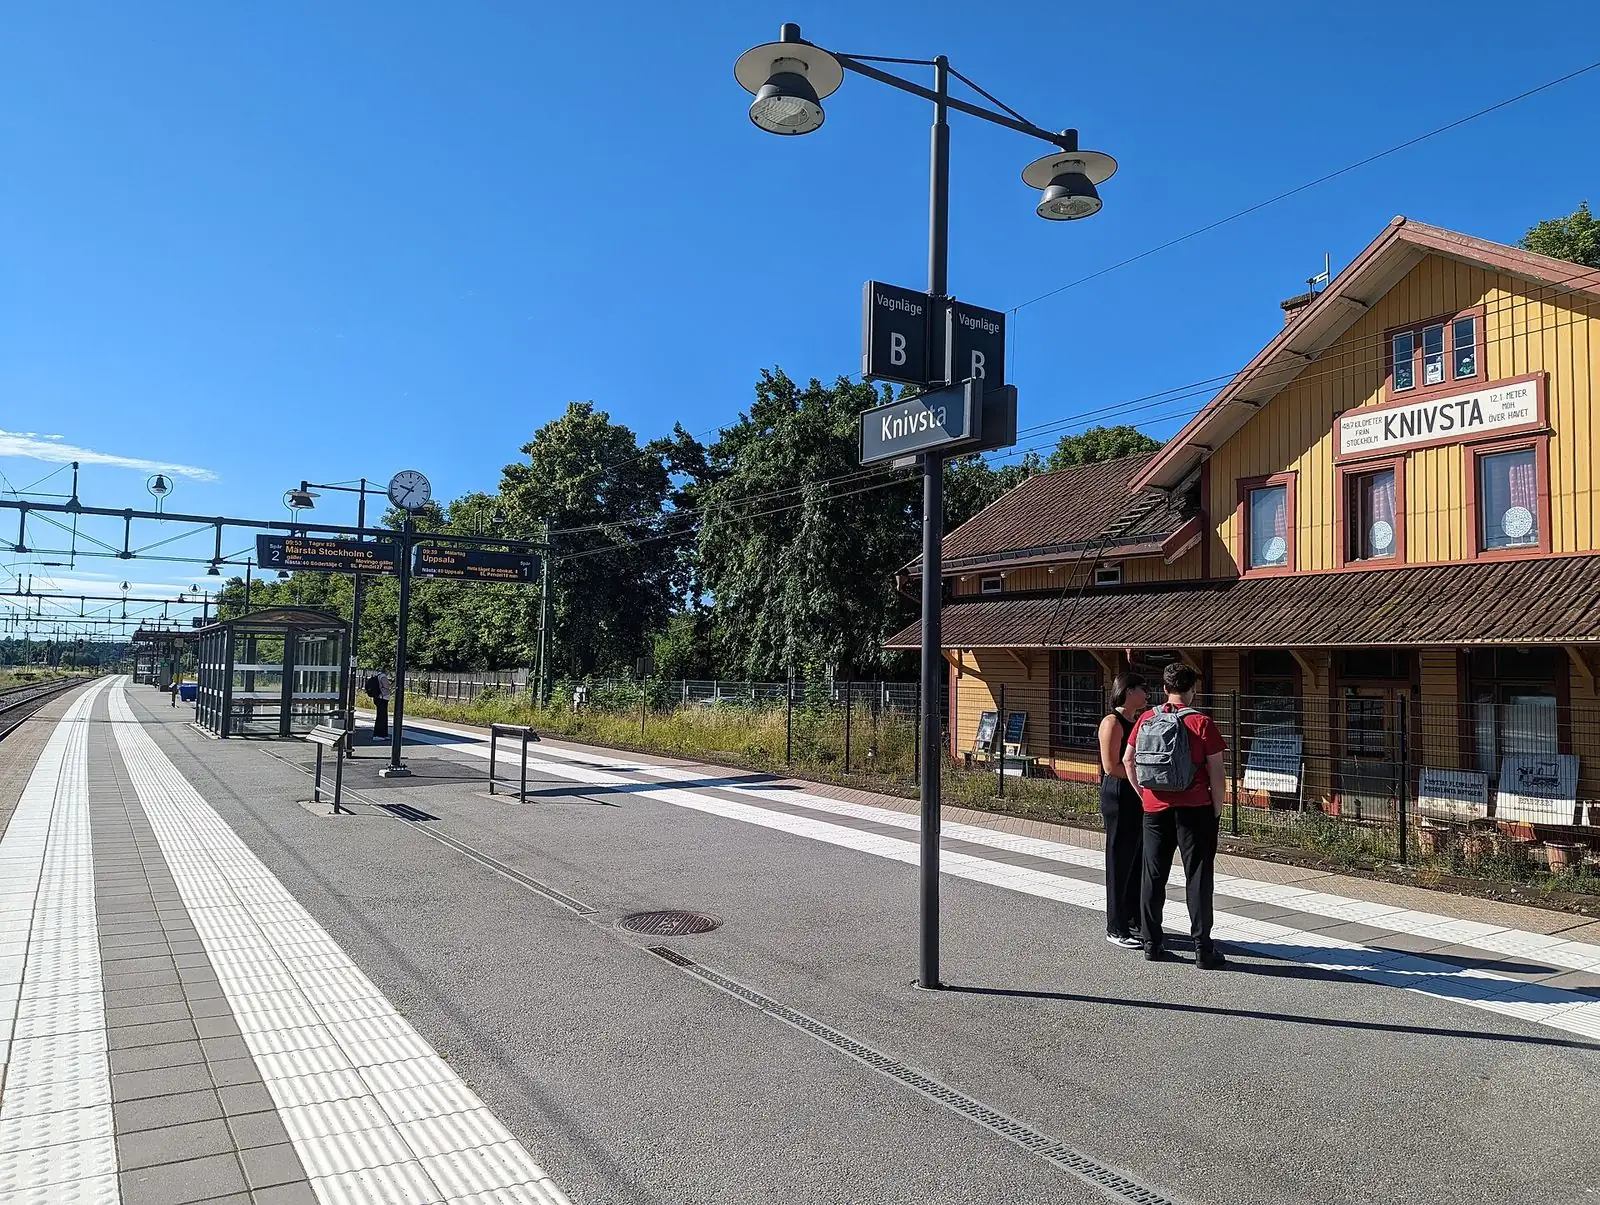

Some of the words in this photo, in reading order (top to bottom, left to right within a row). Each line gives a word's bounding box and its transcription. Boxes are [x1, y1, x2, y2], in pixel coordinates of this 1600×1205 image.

[876, 293, 923, 316] Vagnläge
[959, 313, 1000, 335] Vagnläge
[890, 332, 907, 366] B
[971, 350, 986, 379] B
[1506, 389, 1528, 399] METER
[1384, 398, 1484, 441] KNIVSTA
[1508, 408, 1528, 419] HAVET
[881, 404, 947, 441] Knivsta
[1346, 435, 1379, 448] STOCKHOLM
[271, 550, 280, 561] 2
[285, 545, 316, 555] Märsta
[318, 547, 365, 558] Stockholm
[366, 550, 373, 558] C
[422, 555, 455, 564] Uppsala
[523, 567, 528, 577] 1
